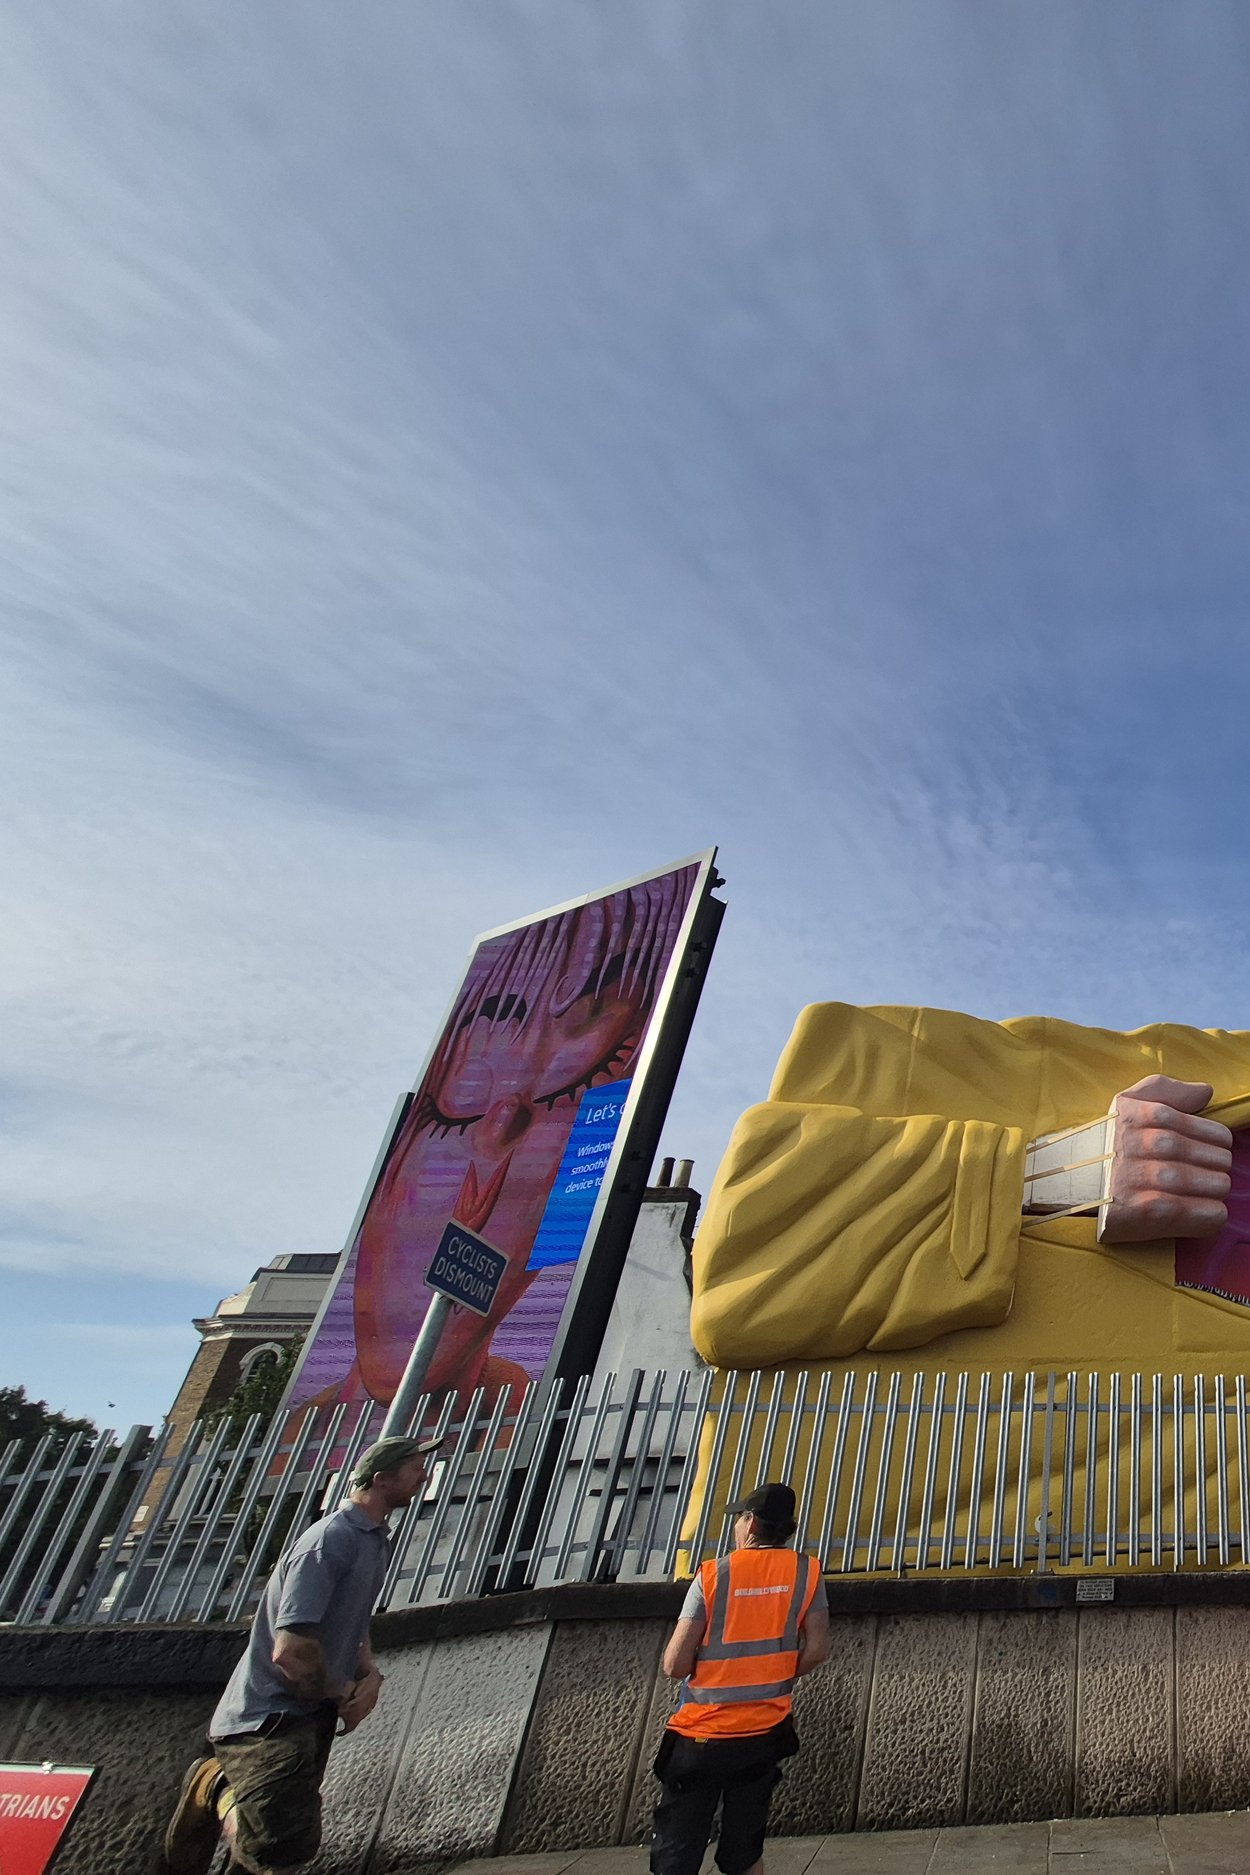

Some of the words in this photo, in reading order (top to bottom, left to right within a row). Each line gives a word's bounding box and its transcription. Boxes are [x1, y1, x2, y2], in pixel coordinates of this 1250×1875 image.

[585, 1102, 617, 1125] Let's
[565, 1178, 593, 1194] device
[448, 1236, 497, 1279] CYCLISTS
[434, 1256, 494, 1302] DISMOUNT
